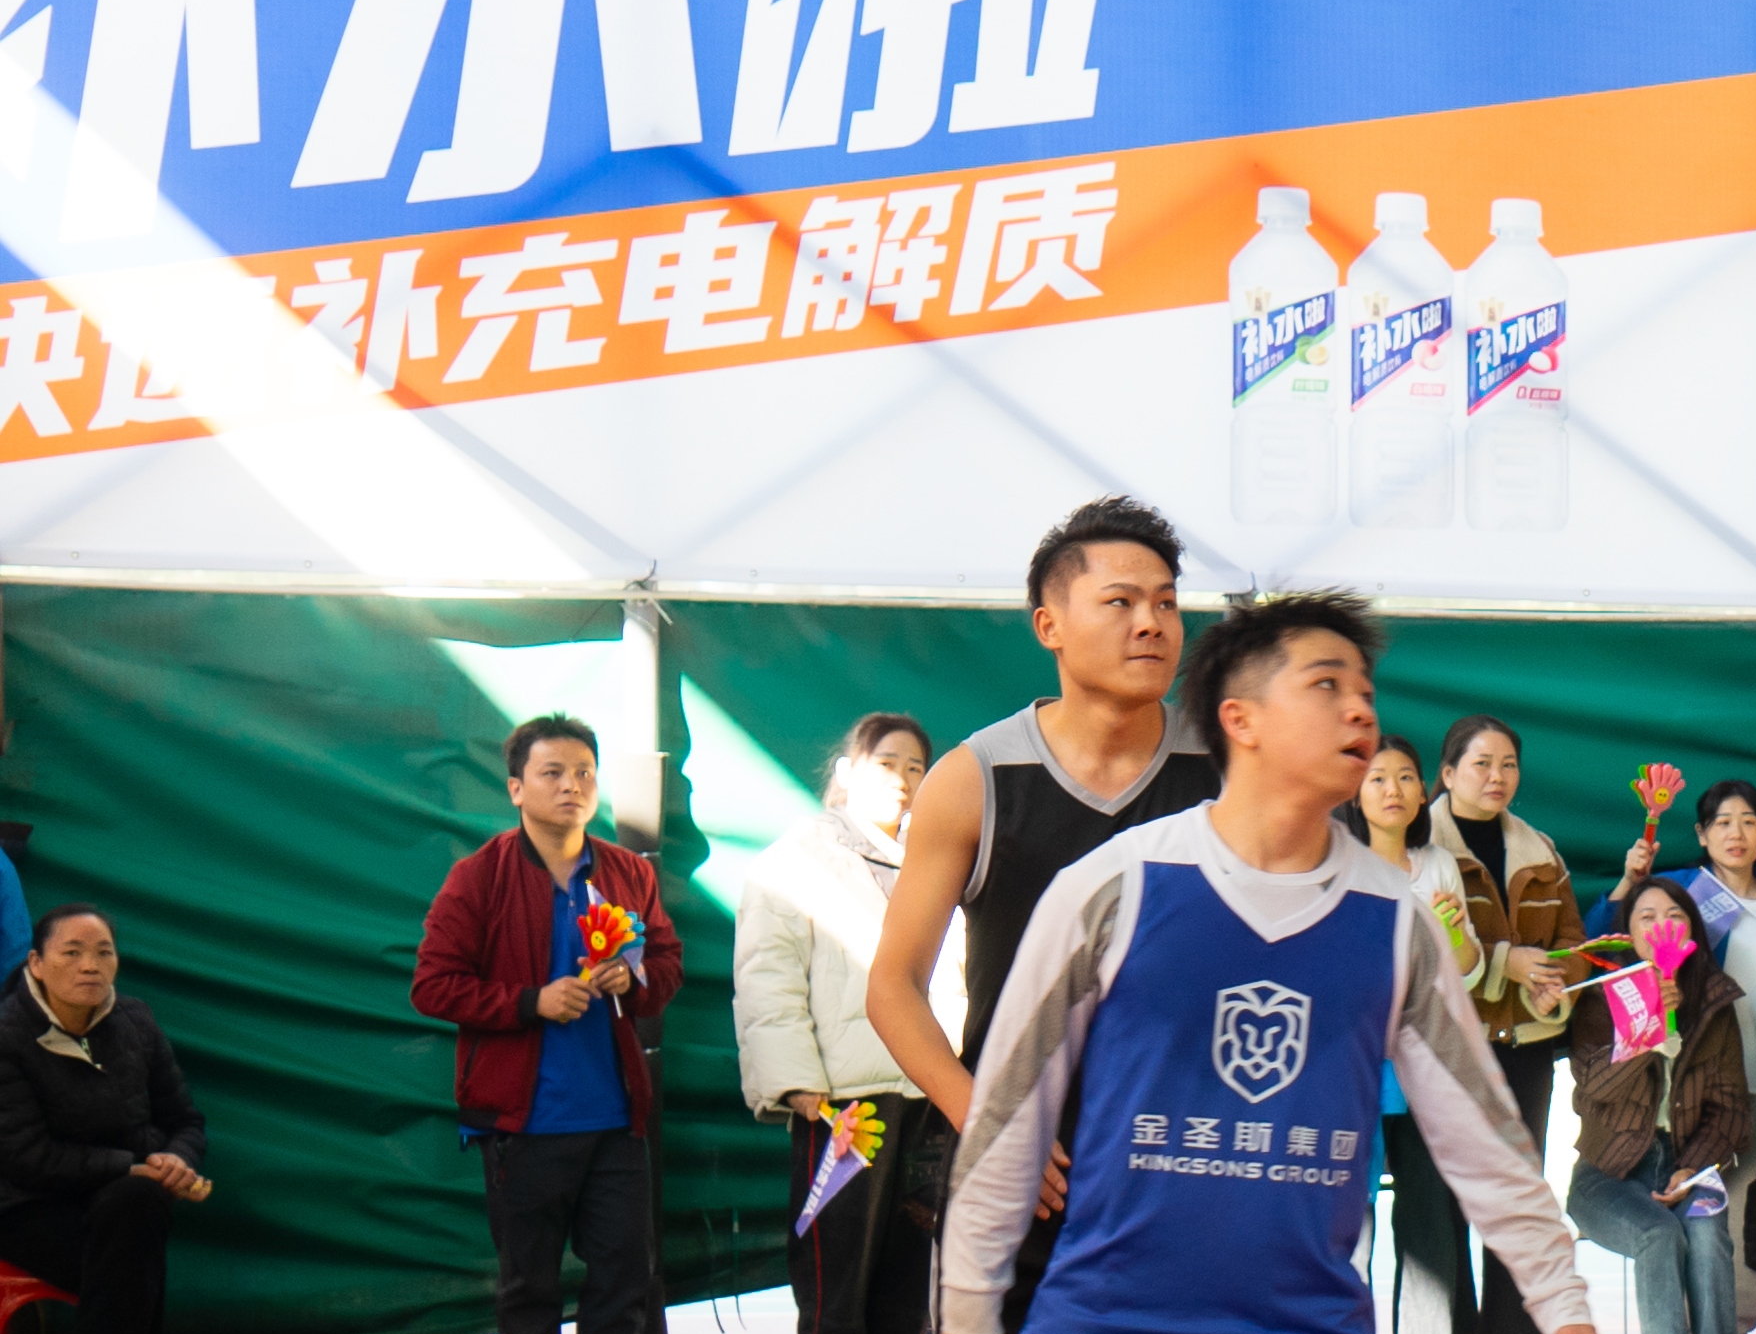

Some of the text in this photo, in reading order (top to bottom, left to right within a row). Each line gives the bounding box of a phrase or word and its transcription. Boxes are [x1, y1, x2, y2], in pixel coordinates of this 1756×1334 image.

[1241, 295, 1326, 367] 补水啦
[1360, 301, 1442, 372] 补水啦
[1476, 306, 1557, 376] 补水啦
[1128, 1152, 1350, 1187] KINGSONS GROUP
[1130, 1114, 1359, 1161] 金圣斯集团
